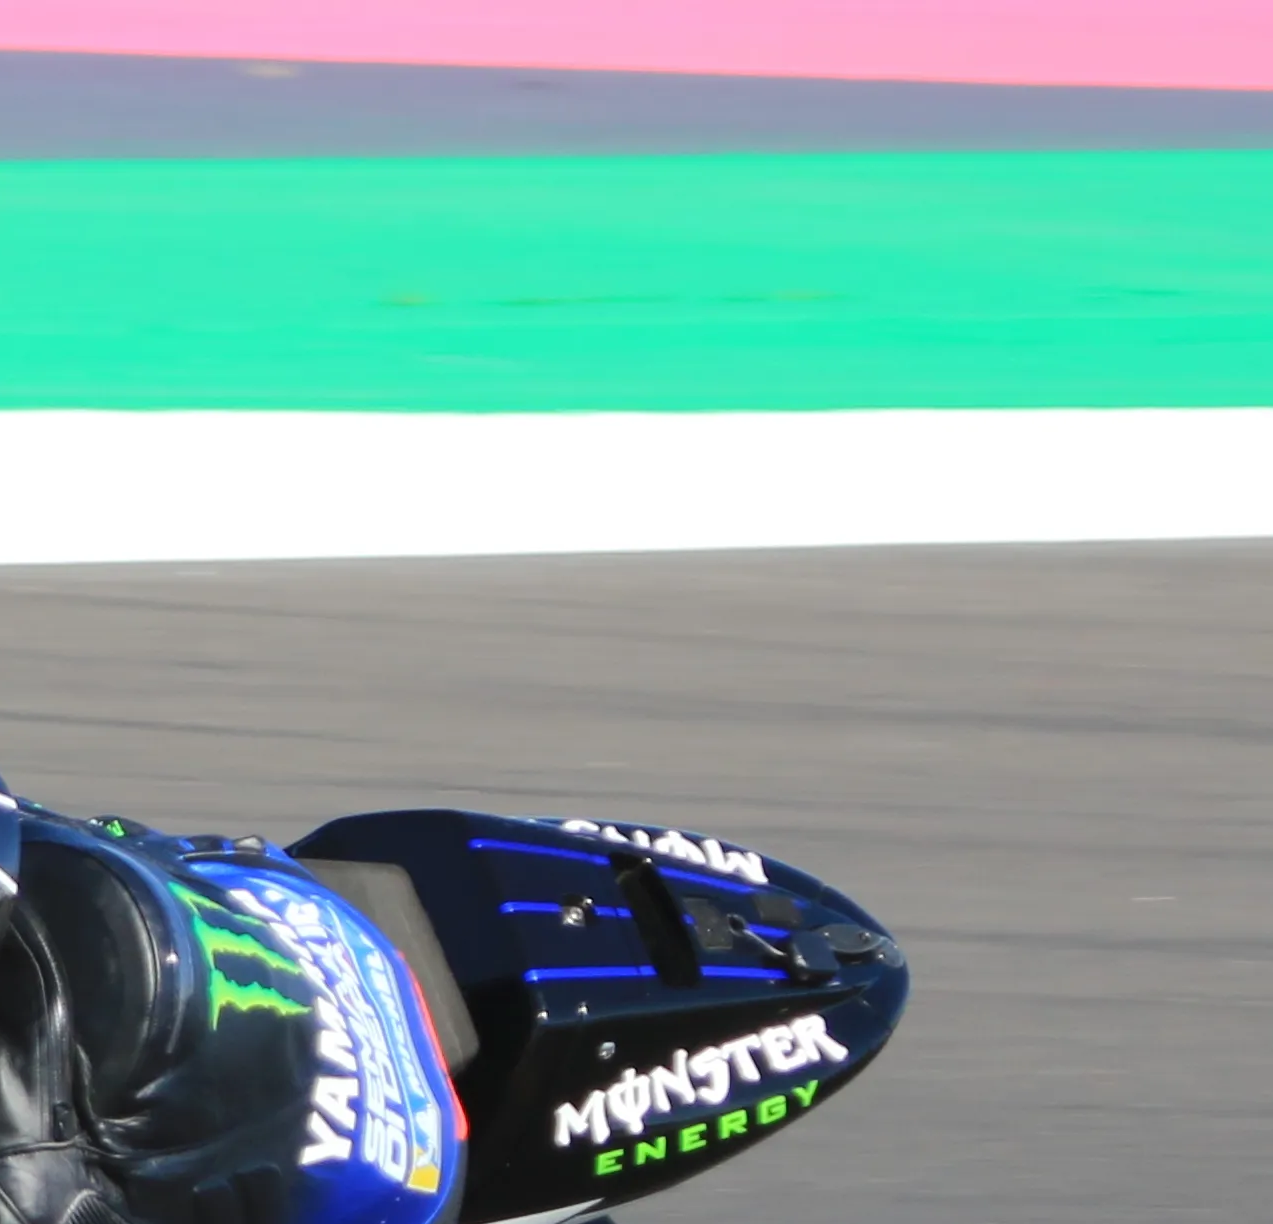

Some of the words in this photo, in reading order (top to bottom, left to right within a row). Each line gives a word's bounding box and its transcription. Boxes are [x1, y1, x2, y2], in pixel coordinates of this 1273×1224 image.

[228, 888, 359, 1167] YAMAHA
[553, 1013, 850, 1147] MONSTER
[594, 1079, 820, 1176] ENERGY
